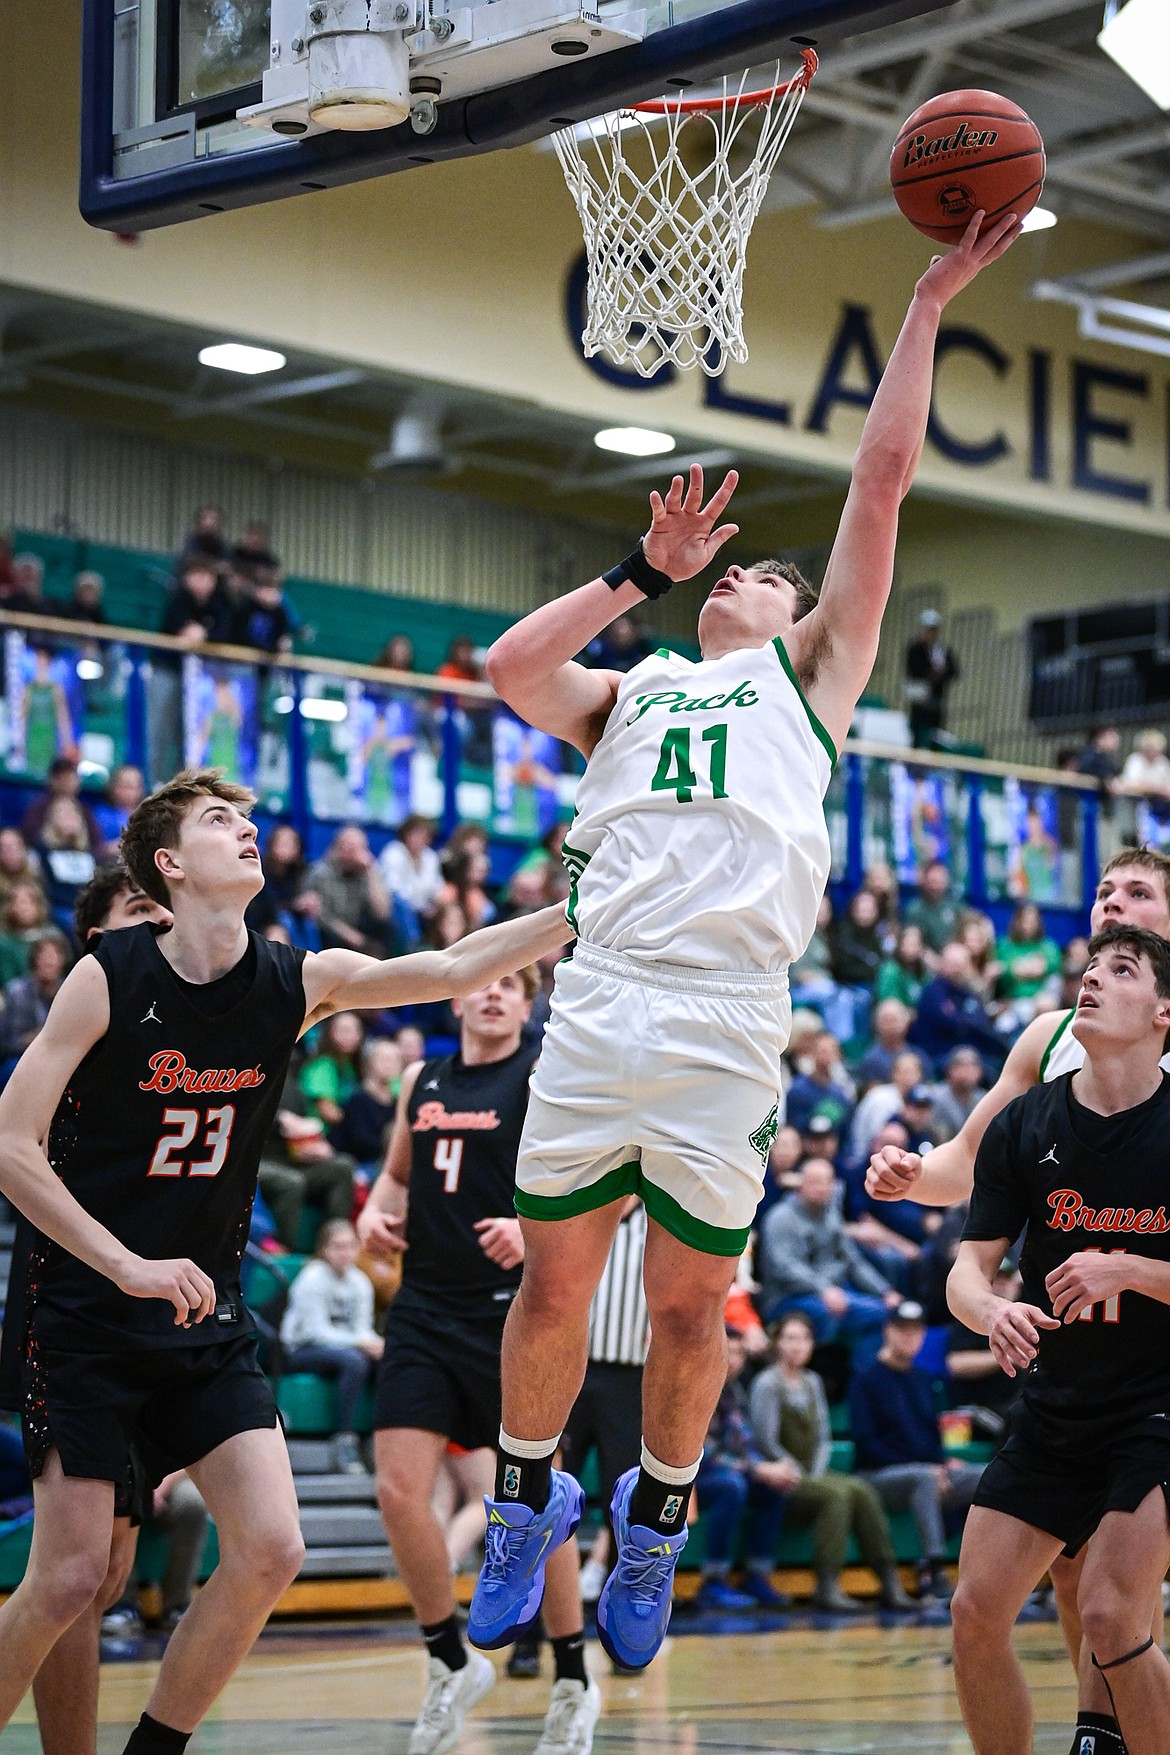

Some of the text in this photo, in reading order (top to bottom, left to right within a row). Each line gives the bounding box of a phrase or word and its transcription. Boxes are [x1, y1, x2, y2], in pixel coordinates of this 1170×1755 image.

[903, 122, 998, 169] Baden
[565, 237, 1170, 511] GLACIE
[626, 680, 760, 727] Pack
[650, 723, 730, 804] 41
[138, 1049, 266, 1095] Braves
[146, 1103, 237, 1178] 23
[432, 1136, 464, 1194] 4
[1045, 1188, 1170, 1235] Braves
